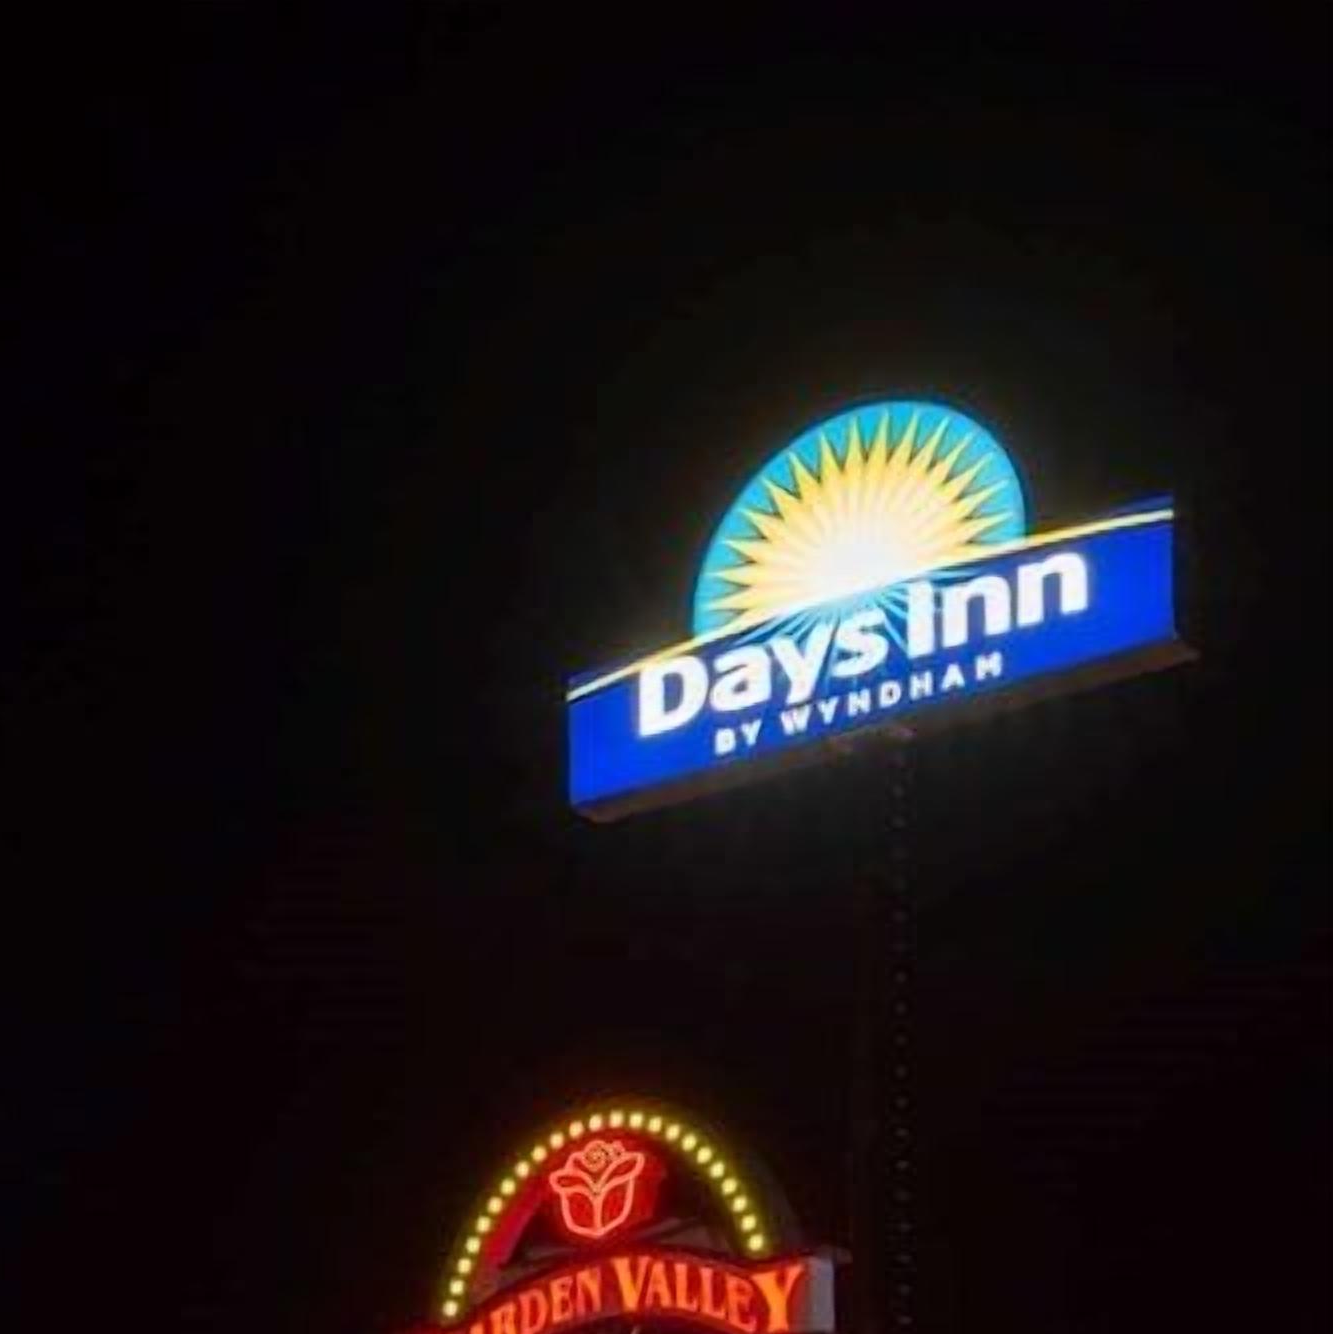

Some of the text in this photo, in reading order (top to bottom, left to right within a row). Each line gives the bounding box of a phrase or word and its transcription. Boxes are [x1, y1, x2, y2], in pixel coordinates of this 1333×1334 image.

[638, 552, 1089, 738] Days Inn
[713, 651, 1004, 756] BY WYNDHAM
[615, 1256, 803, 1334] VALLEY
